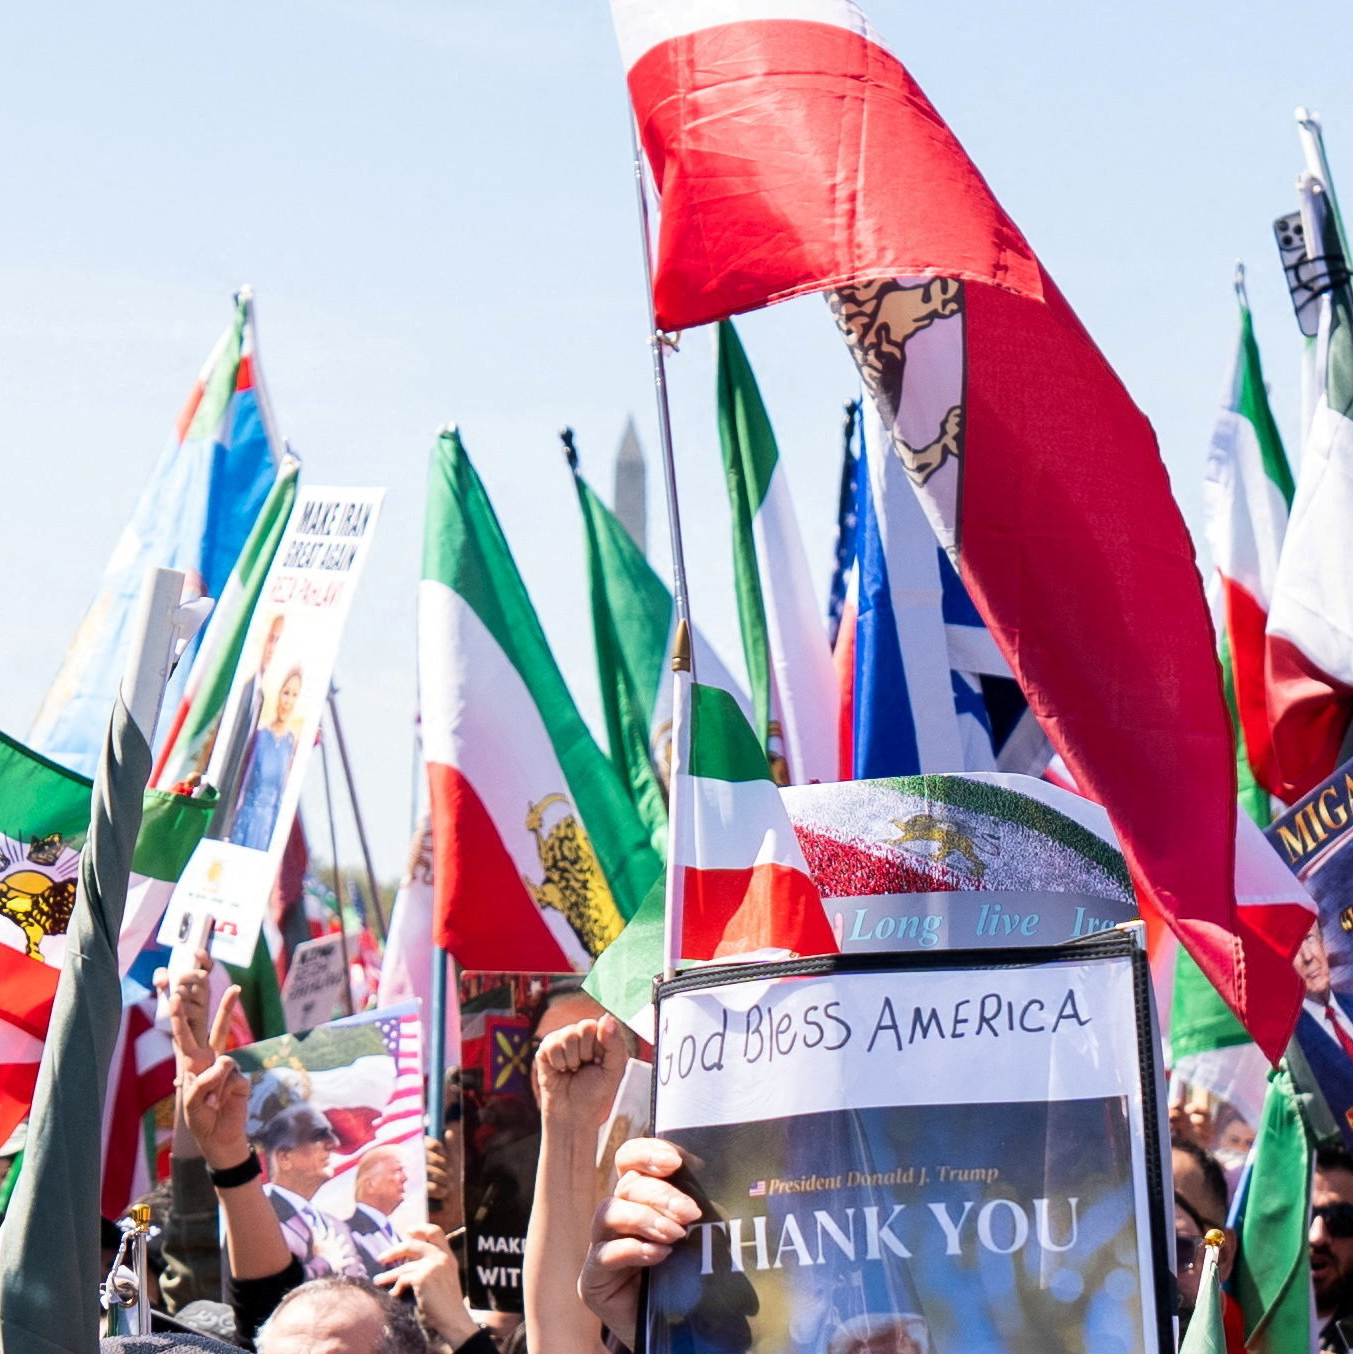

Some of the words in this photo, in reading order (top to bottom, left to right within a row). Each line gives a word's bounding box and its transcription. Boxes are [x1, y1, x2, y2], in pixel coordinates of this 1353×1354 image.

[296, 501, 340, 535] MAKE
[848, 907, 942, 947] Long
[975, 904, 1039, 936] live
[1071, 906, 1115, 937] Ira
[867, 988, 1092, 1052] AMERICA
[769, 1175, 842, 1195] President
[848, 1167, 915, 1187] Donald
[919, 1167, 931, 1186] J.
[937, 1165, 999, 1185] Trump
[477, 1235, 526, 1254] MAK
[687, 1203, 912, 1275] THANK
[928, 1198, 1079, 1257] YOU
[477, 1265, 521, 1288] WIT
